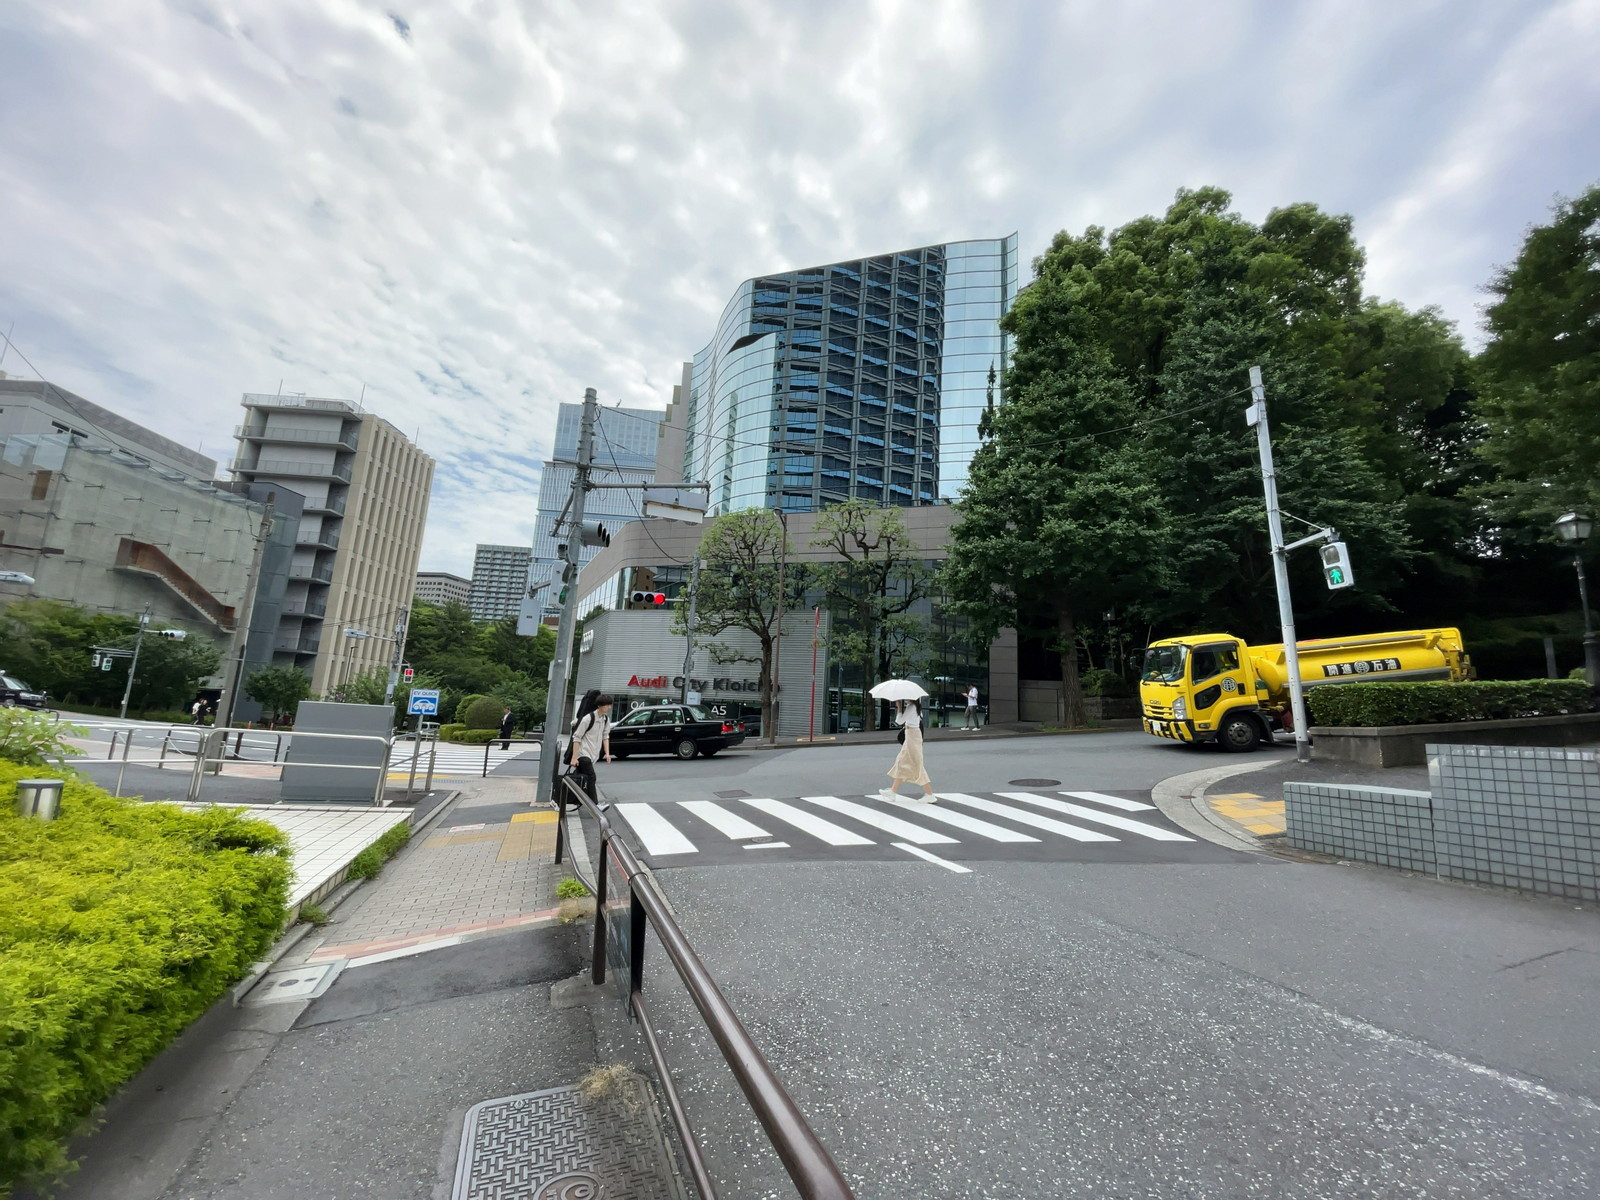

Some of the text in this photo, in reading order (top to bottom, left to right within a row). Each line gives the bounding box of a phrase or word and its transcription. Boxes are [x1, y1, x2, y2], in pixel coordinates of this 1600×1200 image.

[627, 674, 780, 693] Audi Cty Kioic
[711, 705, 727, 715] A5
